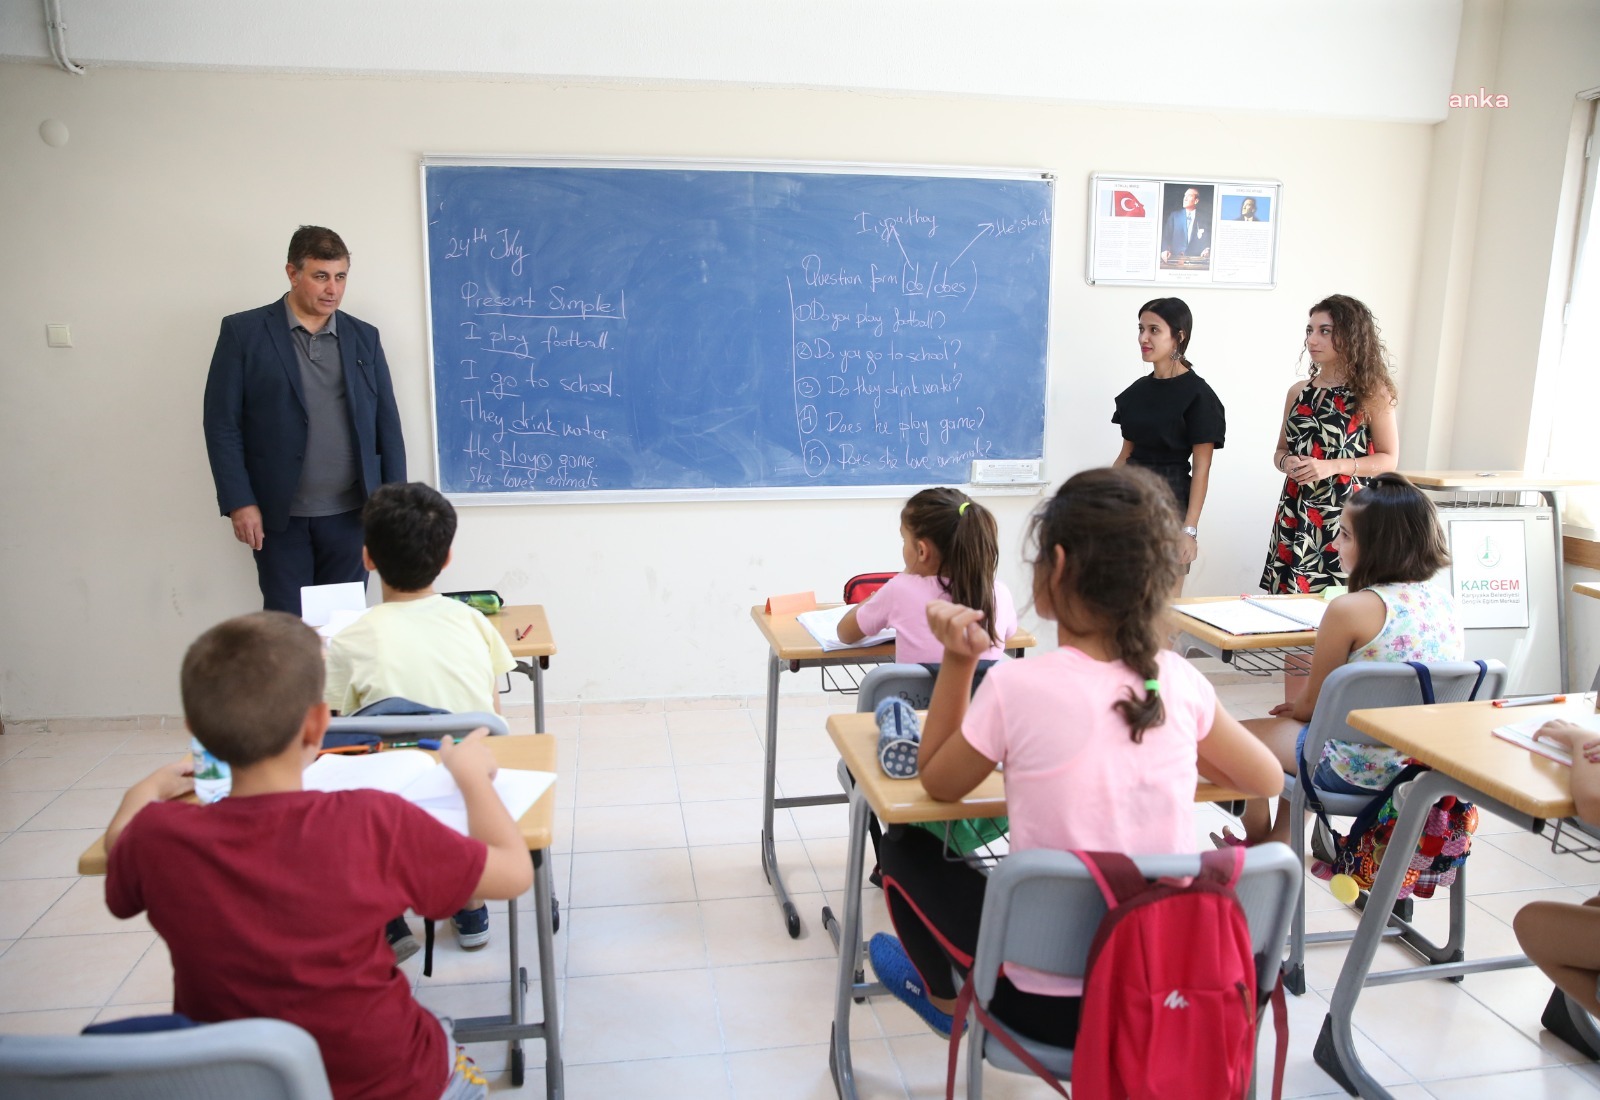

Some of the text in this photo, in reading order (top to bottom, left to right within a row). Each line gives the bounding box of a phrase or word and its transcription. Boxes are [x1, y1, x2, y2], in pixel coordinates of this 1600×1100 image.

[445, 228, 487, 259] 24th
[802, 254, 862, 287] Question
[870, 263, 898, 293] form
[461, 281, 616, 320] Present Simple
[831, 312, 850, 332] you
[856, 303, 883, 338] play
[460, 322, 482, 340] I
[490, 324, 529, 360] play
[814, 337, 835, 359] Do
[840, 350, 862, 373] you
[866, 351, 883, 374] go
[887, 340, 904, 361] to
[460, 359, 480, 380] I
[490, 372, 517, 400] go
[525, 362, 550, 388] to
[827, 376, 850, 397] Do
[853, 376, 881, 409] they
[884, 370, 920, 398] drink
[460, 392, 507, 443] They
[511, 401, 556, 434] drink
[825, 411, 863, 433] Does
[874, 408, 893, 434] he
[899, 413, 929, 445] play
[463, 432, 491, 461] He
[837, 443, 871, 470] Does
[878, 445, 899, 470] she
[905, 444, 932, 470] love
[465, 462, 494, 488] She
[1460, 579, 1521, 591] KARGEM
